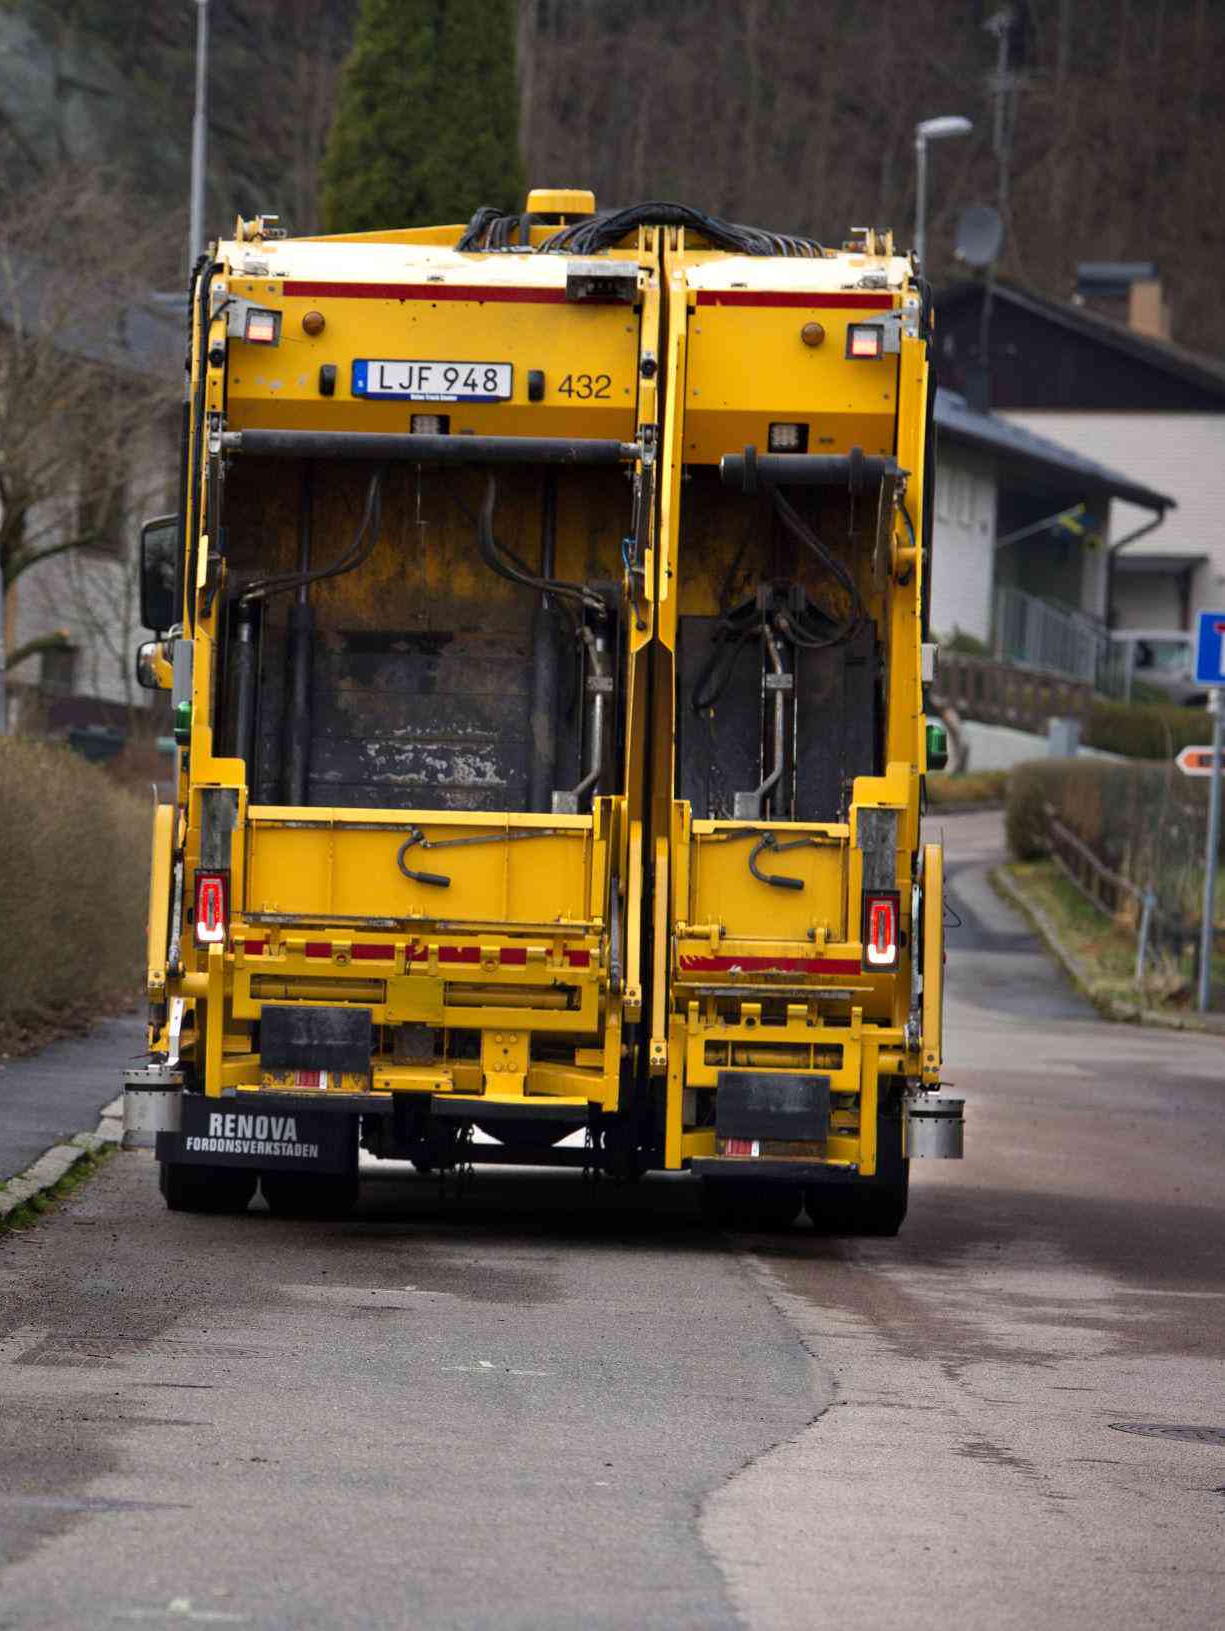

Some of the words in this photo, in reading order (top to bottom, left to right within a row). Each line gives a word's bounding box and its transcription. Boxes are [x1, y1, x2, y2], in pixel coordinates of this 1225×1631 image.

[379, 365, 432, 391] LJF
[443, 367, 498, 392] 948
[558, 374, 612, 399] 432
[209, 1112, 297, 1141] RENOVA
[186, 1136, 319, 1158] FORDONSVERKSTADEN
